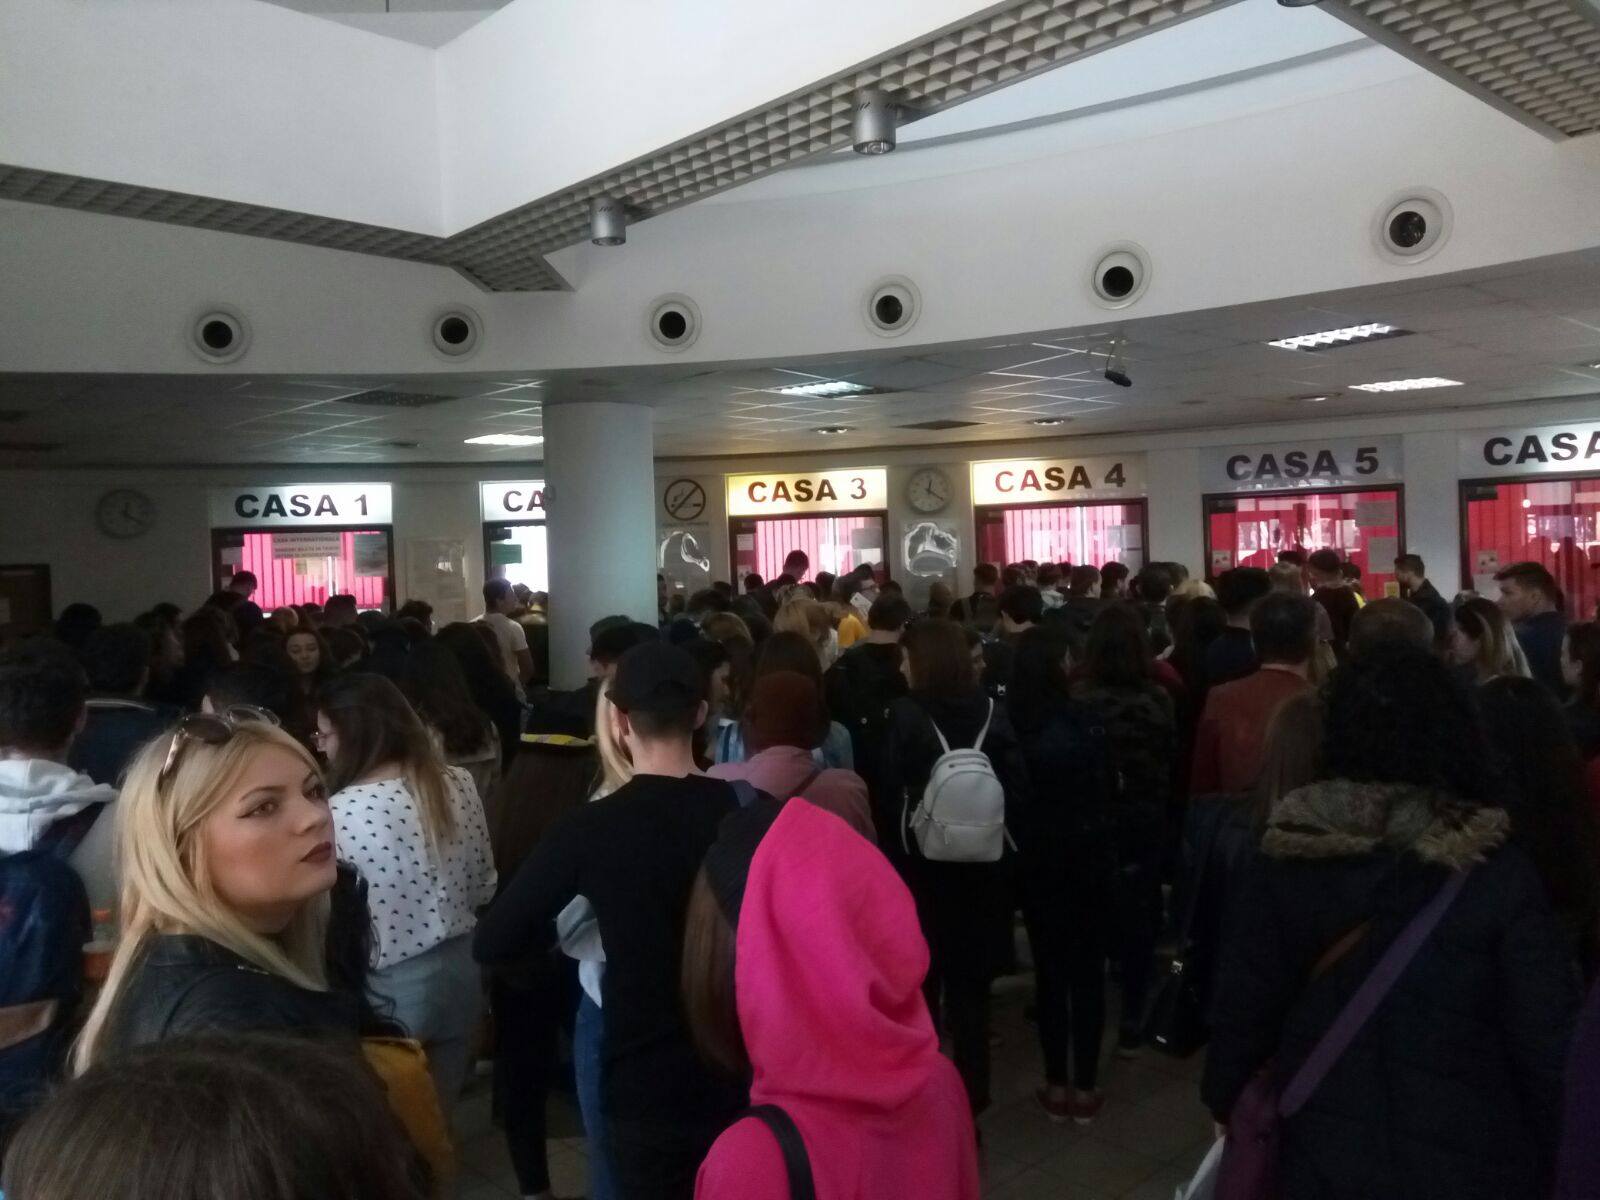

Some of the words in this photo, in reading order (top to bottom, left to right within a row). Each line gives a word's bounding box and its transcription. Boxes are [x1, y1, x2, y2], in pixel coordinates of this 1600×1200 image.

[994, 465, 1092, 492] CASA
[1104, 462, 1126, 488] 4
[1226, 450, 1340, 481] CASA
[1355, 447, 1379, 475] 5
[503, 490, 546, 512] CA
[748, 479, 838, 503] CASA
[850, 477, 867, 500] 3
[235, 494, 339, 518] CASA
[354, 494, 368, 516] 1
